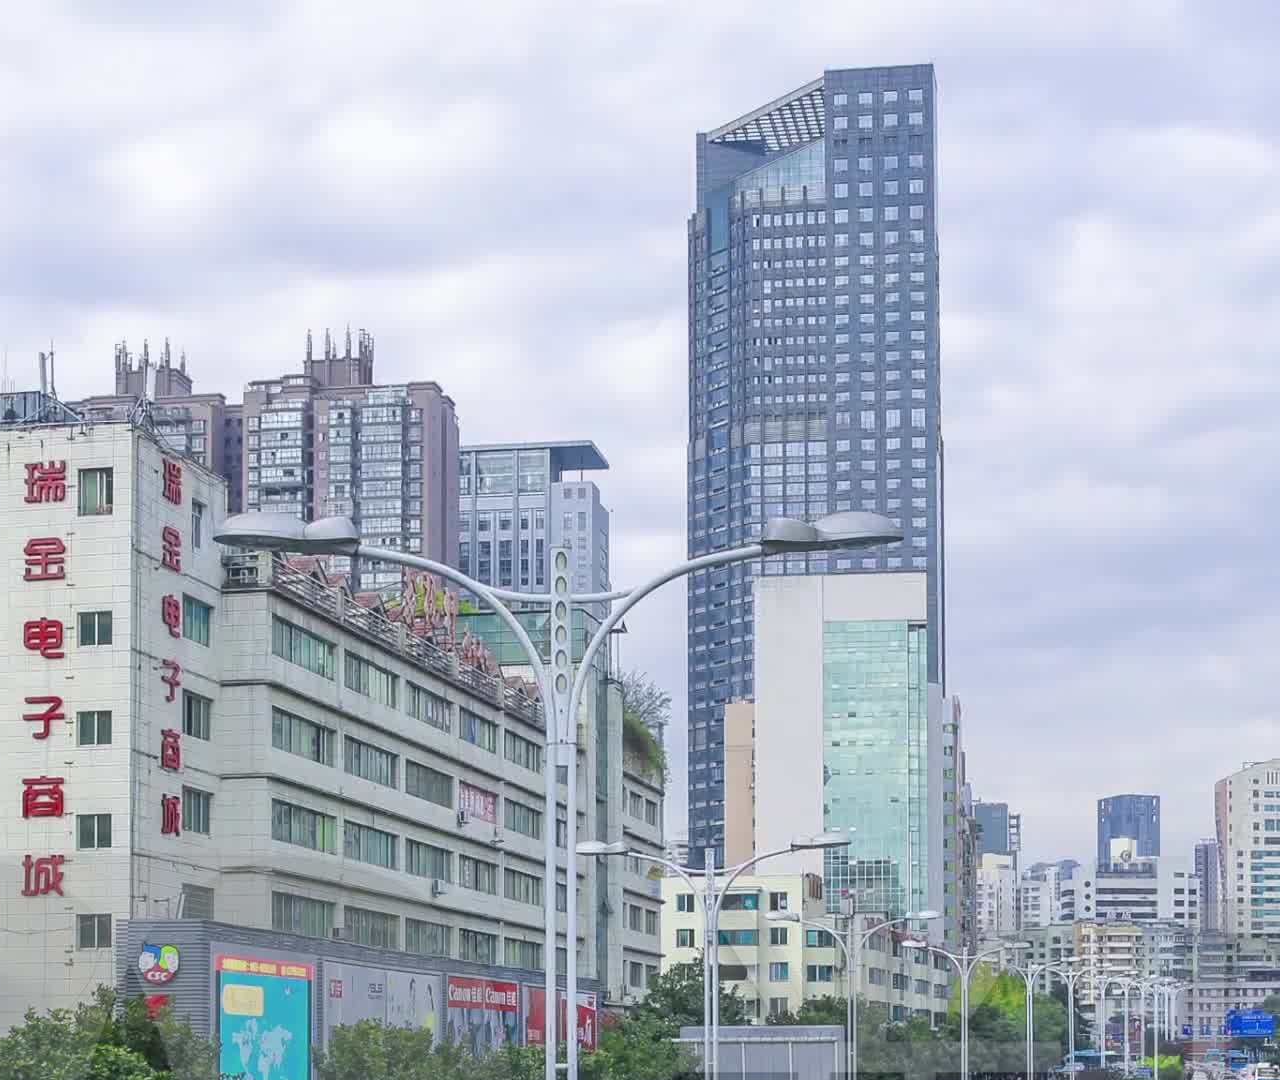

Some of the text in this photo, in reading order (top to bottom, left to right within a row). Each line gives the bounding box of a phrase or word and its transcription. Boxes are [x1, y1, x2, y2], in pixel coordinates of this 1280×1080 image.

[23, 459, 67, 897] 瑞金电子商城
[160, 457, 183, 838] 瑞金电子商城
